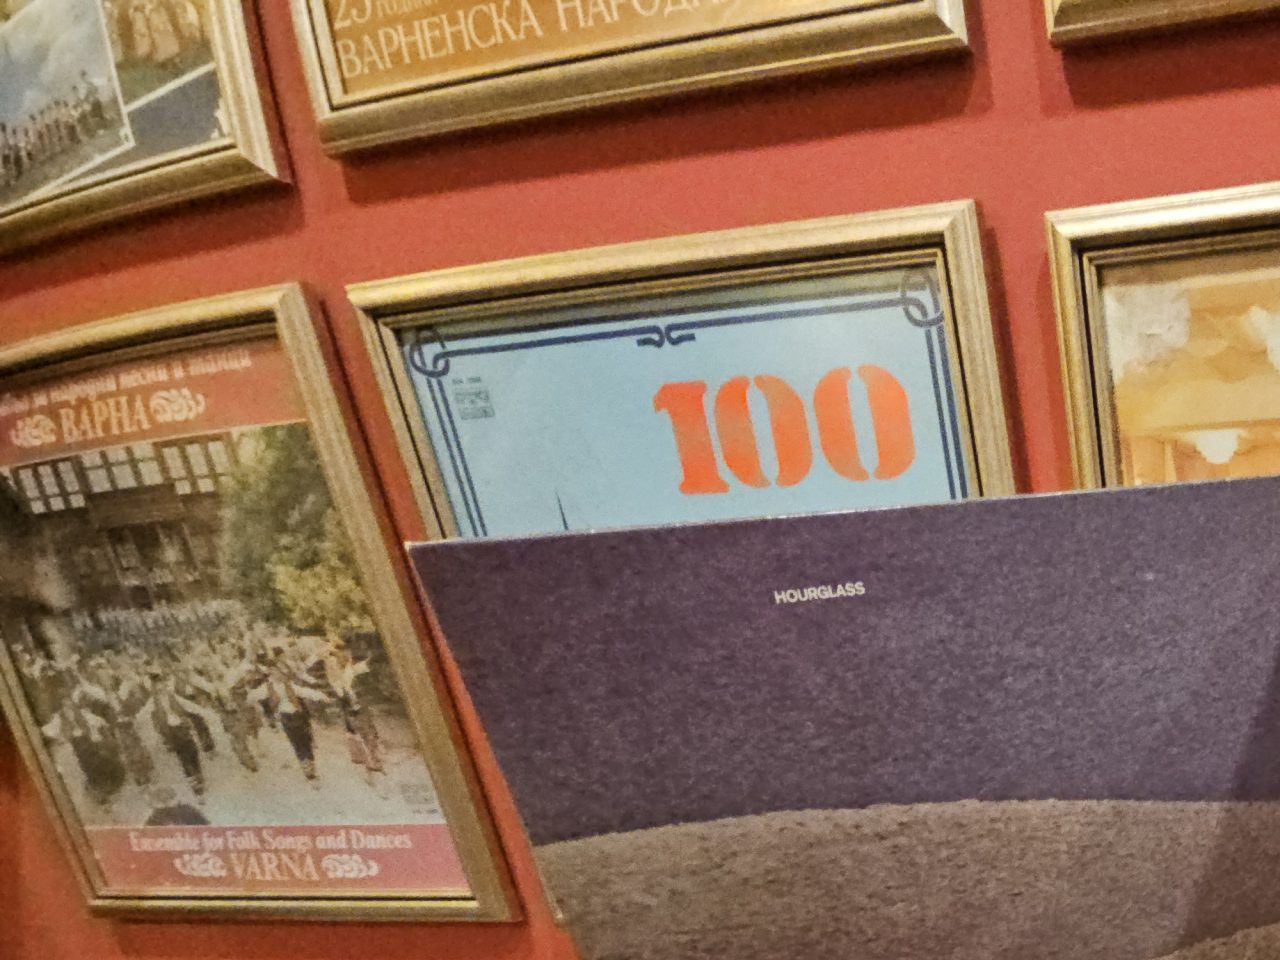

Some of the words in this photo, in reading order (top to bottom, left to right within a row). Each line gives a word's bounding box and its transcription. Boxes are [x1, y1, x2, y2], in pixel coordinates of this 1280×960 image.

[336, 2, 544, 79] ВАРНЕНСКА
[59, 394, 152, 444] ВАРНА
[652, 364, 916, 496] 100
[774, 581, 866, 604] HOURGLASS
[227, 829, 262, 851] Folk
[262, 829, 314, 853] Songs
[315, 829, 347, 850] and
[350, 829, 412, 850] Dances
[230, 852, 321, 881] VARNA
